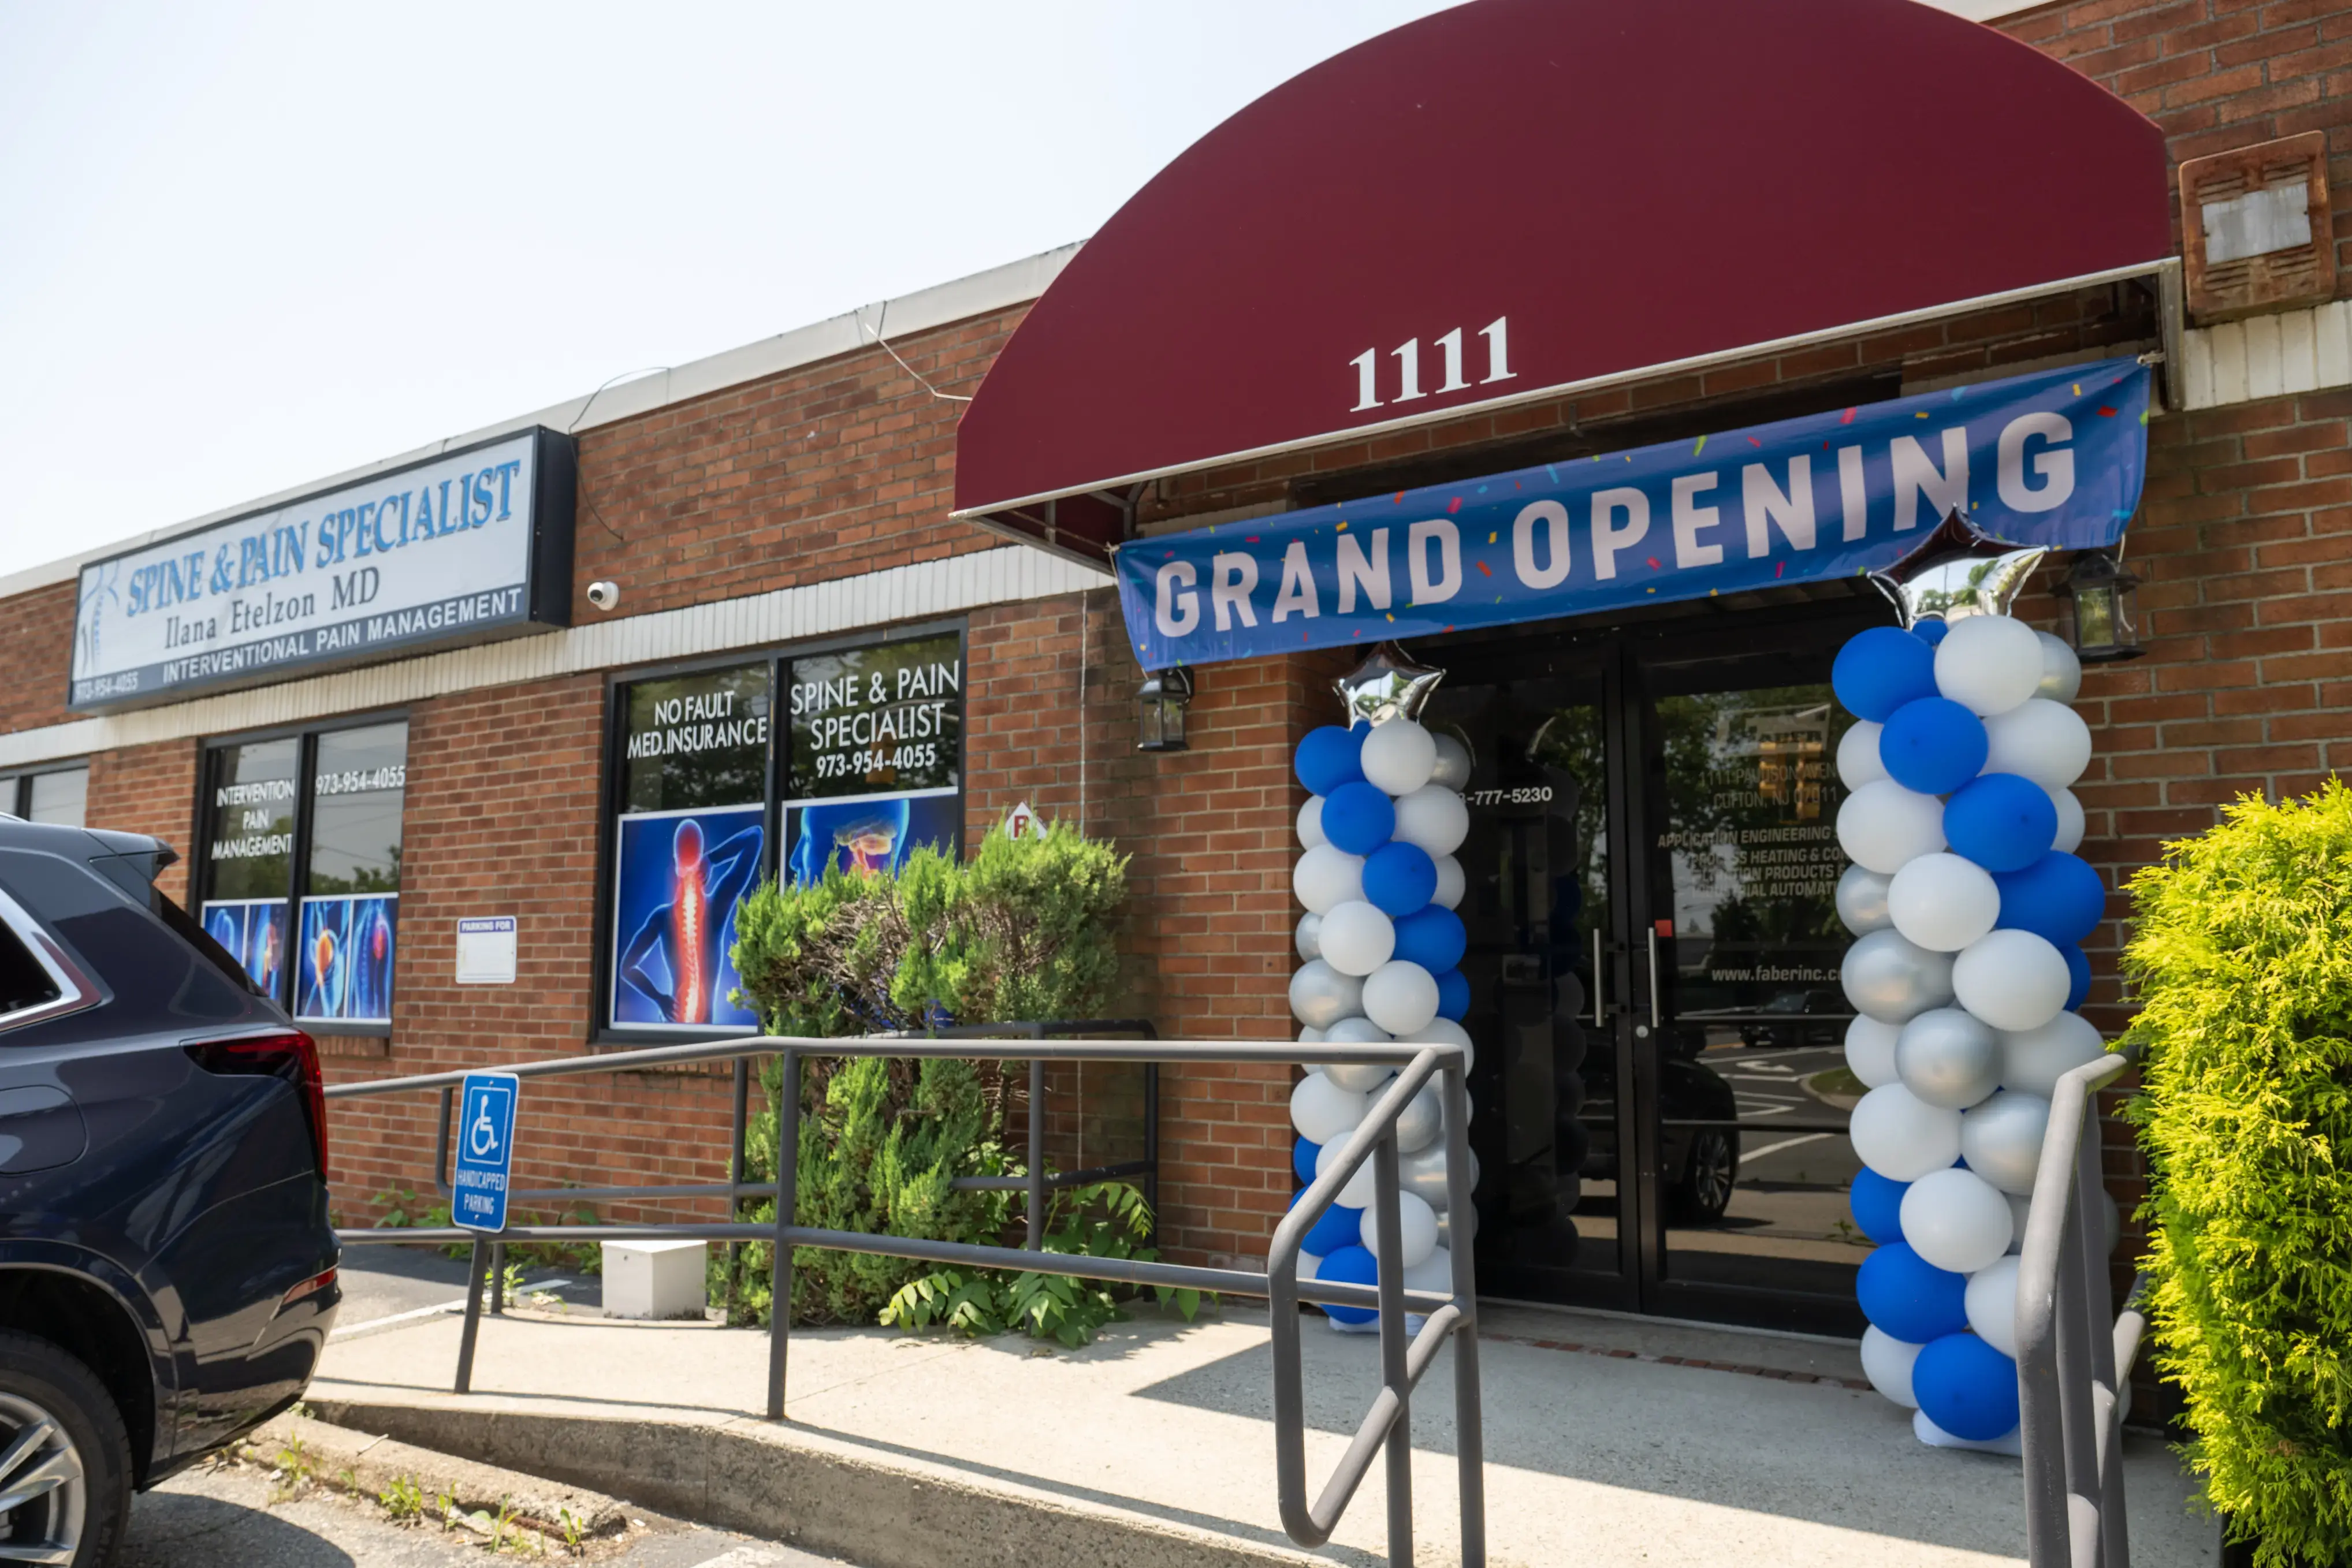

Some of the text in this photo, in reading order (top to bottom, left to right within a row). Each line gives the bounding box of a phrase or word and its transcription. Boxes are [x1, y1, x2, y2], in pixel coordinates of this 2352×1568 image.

[1349, 316, 1517, 413] 1111
[128, 459, 521, 617] SPINE & PAIN SPECIALIST
[1155, 411, 2076, 638] GRAND OPENING
[164, 566, 379, 649] Ilana Etelzon MD
[163, 587, 522, 683] INTERVENTIONAL PAIN MANAGEMENT
[790, 660, 959, 715] SPINE & PAIN
[654, 690, 734, 726] NO FAULT
[811, 702, 946, 751] SPECIALIST
[817, 743, 936, 779] 973-954-4055
[1803, 762, 1836, 780] AVEN
[217, 779, 295, 807] INTERVENTION
[315, 765, 405, 796] 973-954-4055
[243, 809, 269, 830] PAIN
[1740, 825, 1832, 844] ENGINEERING
[212, 833, 292, 860] MANAGEMENT
[1750, 848, 1807, 865] HEATING
[1810, 847, 1819, 862] &
[1765, 863, 1834, 881] PRODUCTS
[1770, 881, 1838, 897] AUTOMATI
[464, 1193, 494, 1215] PARKING
